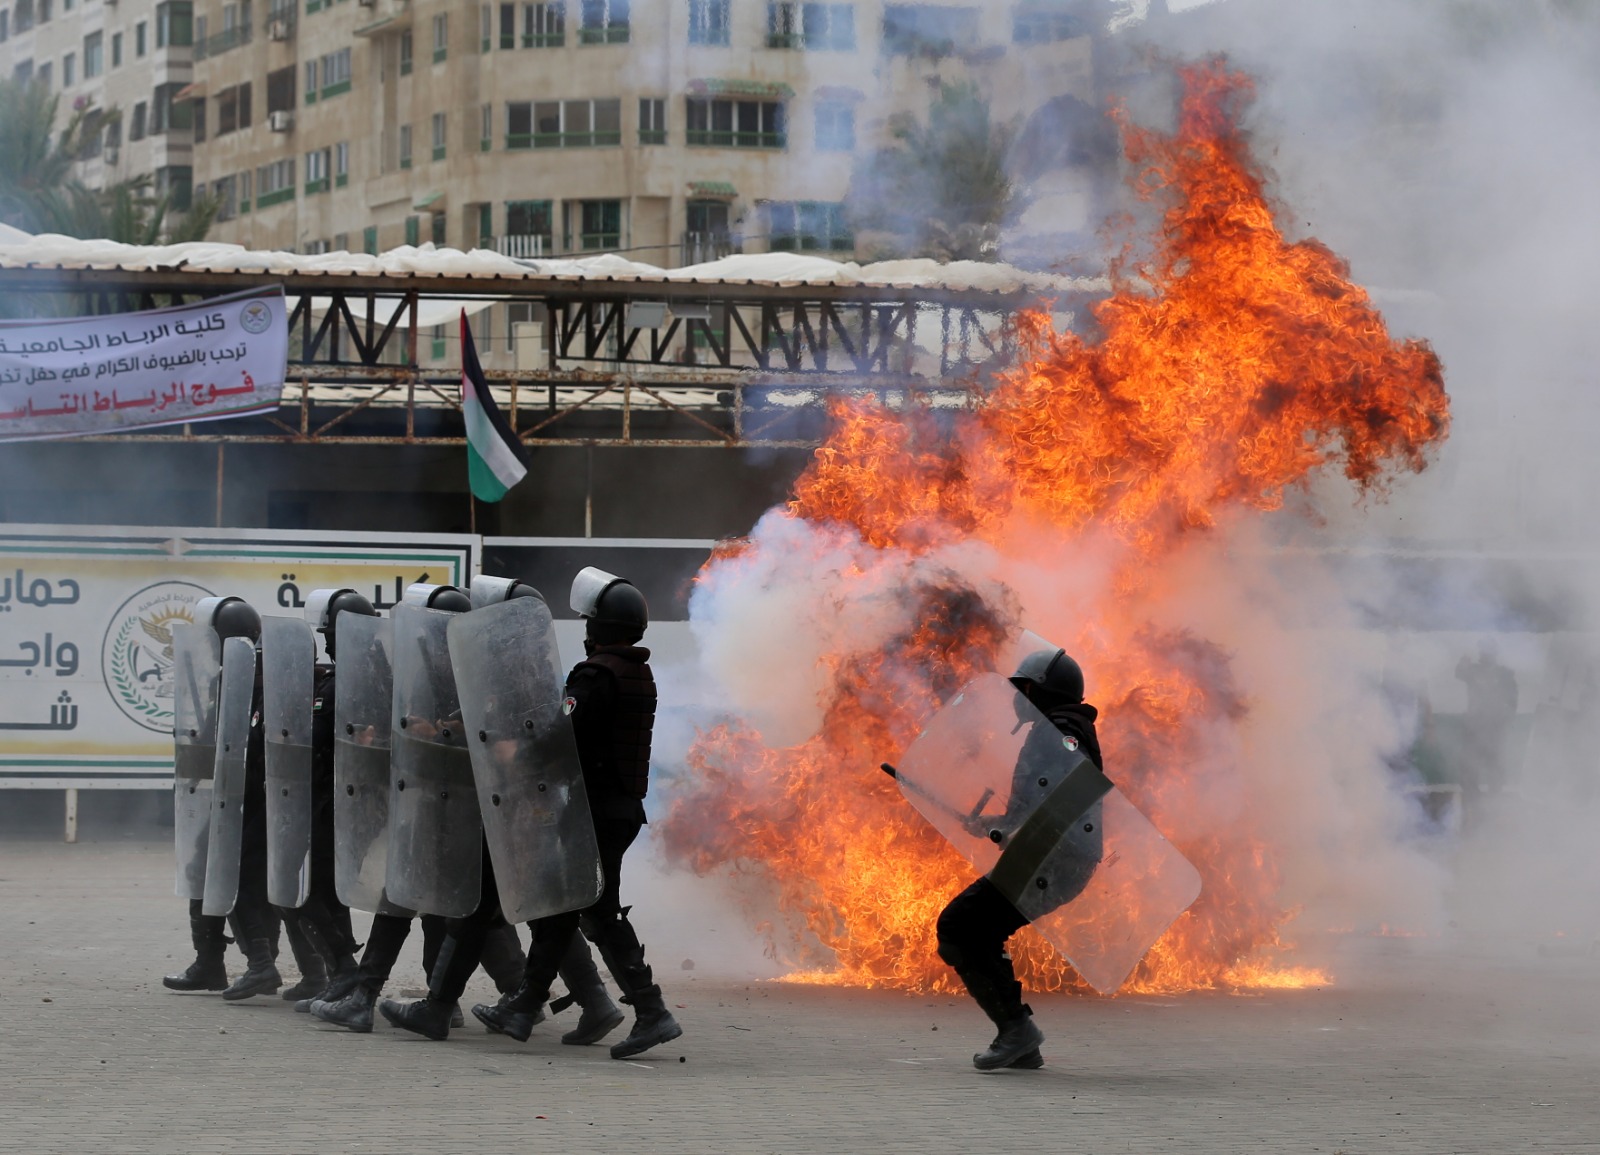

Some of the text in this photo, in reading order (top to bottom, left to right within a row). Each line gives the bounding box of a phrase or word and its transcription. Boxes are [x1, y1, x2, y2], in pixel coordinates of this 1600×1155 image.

[106, 324, 170, 348] الرباط
[174, 313, 225, 338] كلية
[0, 342, 247, 386] ترحب بالضيوف الكرام في حفل تخ
[0, 370, 255, 419] فوج الرباط التاس
[0, 568, 80, 612] حماي
[277, 572, 430, 610] لية
[0, 632, 79, 677] واج
